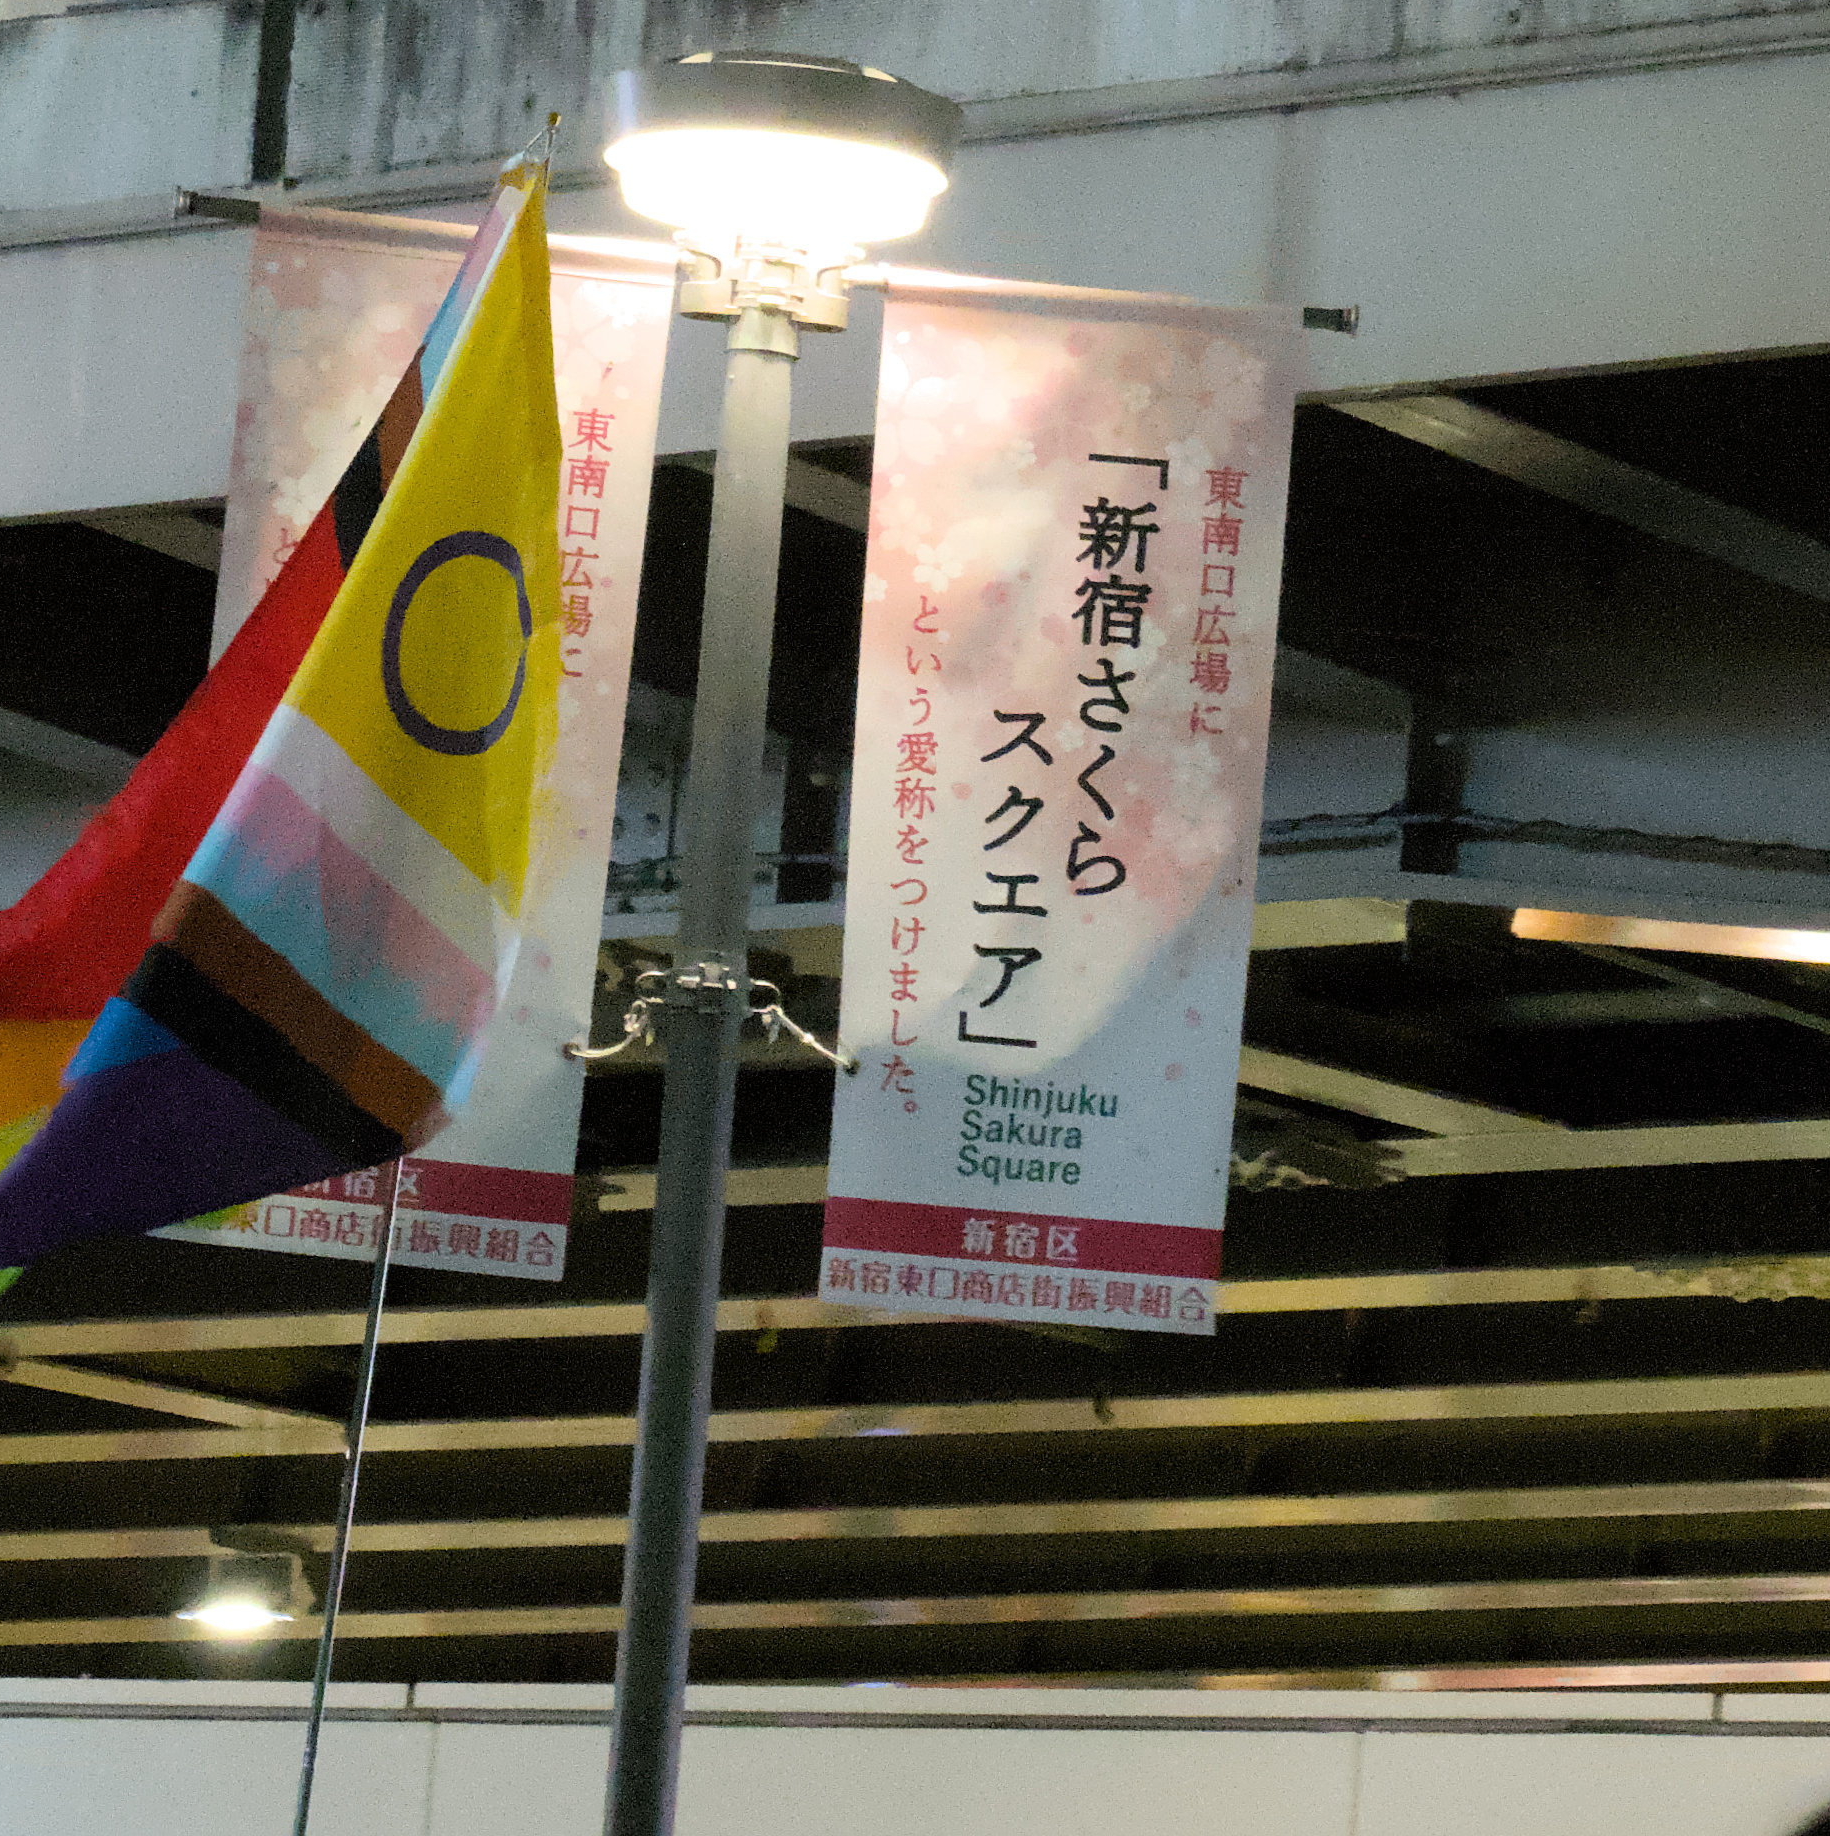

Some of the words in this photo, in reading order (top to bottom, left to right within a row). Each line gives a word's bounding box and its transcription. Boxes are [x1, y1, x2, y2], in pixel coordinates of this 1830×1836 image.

[1189, 465, 1250, 736] 東南口広場に
[1065, 451, 1170, 898] 「新宿さくら
[879, 594, 944, 1115] という愛称をつけました。
[957, 708, 1055, 1050] スクエア」
[958, 1108, 1084, 1151] Sakura
[962, 1073, 1120, 1120] Shinjuku
[955, 1143, 1082, 1186] Square
[961, 1217, 1080, 1263] 新宿区
[825, 1255, 1211, 1324] 新宿東口商店街振興組合
